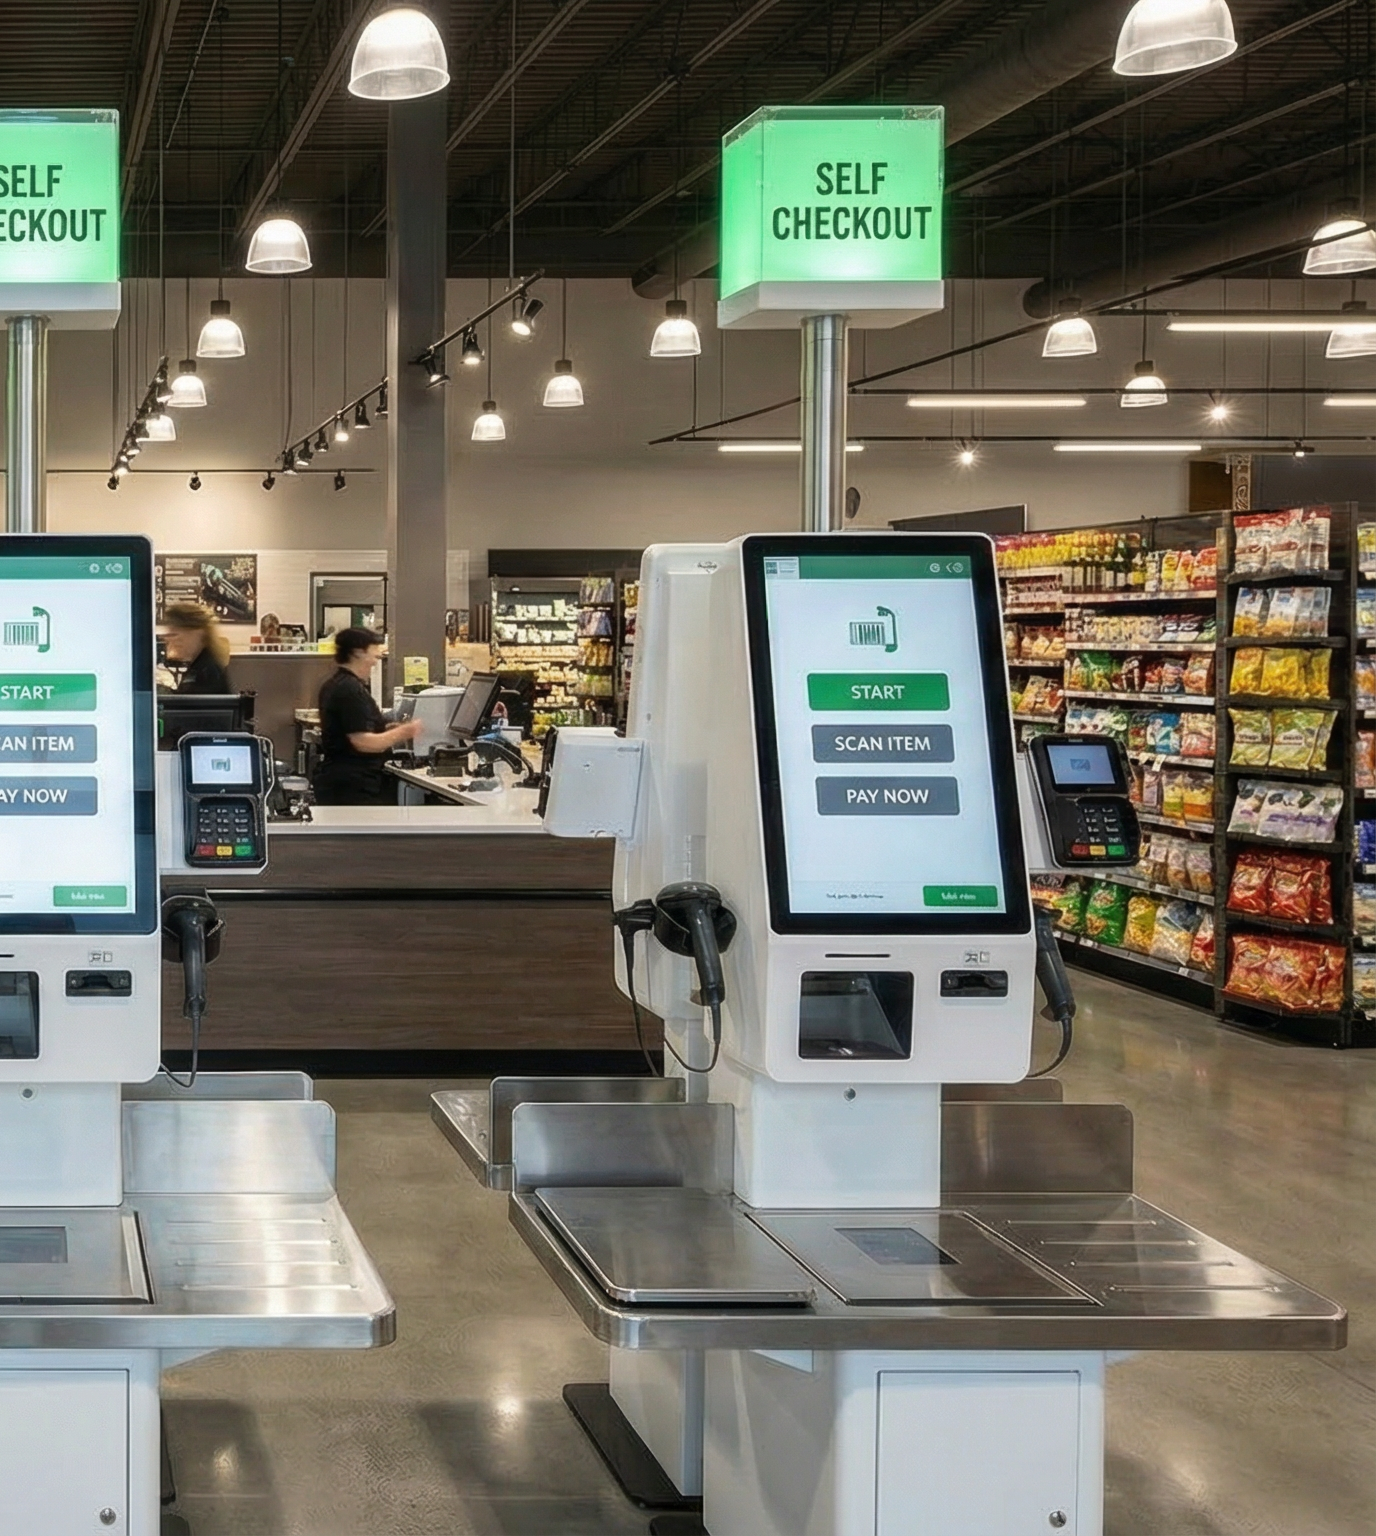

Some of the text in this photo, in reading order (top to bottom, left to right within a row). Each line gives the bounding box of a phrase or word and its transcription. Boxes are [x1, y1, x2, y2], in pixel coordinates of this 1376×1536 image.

[816, 161, 889, 196] SELF
[772, 205, 933, 241] CHECKOUT
[0, 685, 55, 701] START
[850, 684, 905, 700] START
[32, 735, 75, 752] ITEM
[834, 736, 931, 752] SCAN ITEM
[23, 788, 68, 804] NOW
[846, 788, 929, 804] PAY NOW
